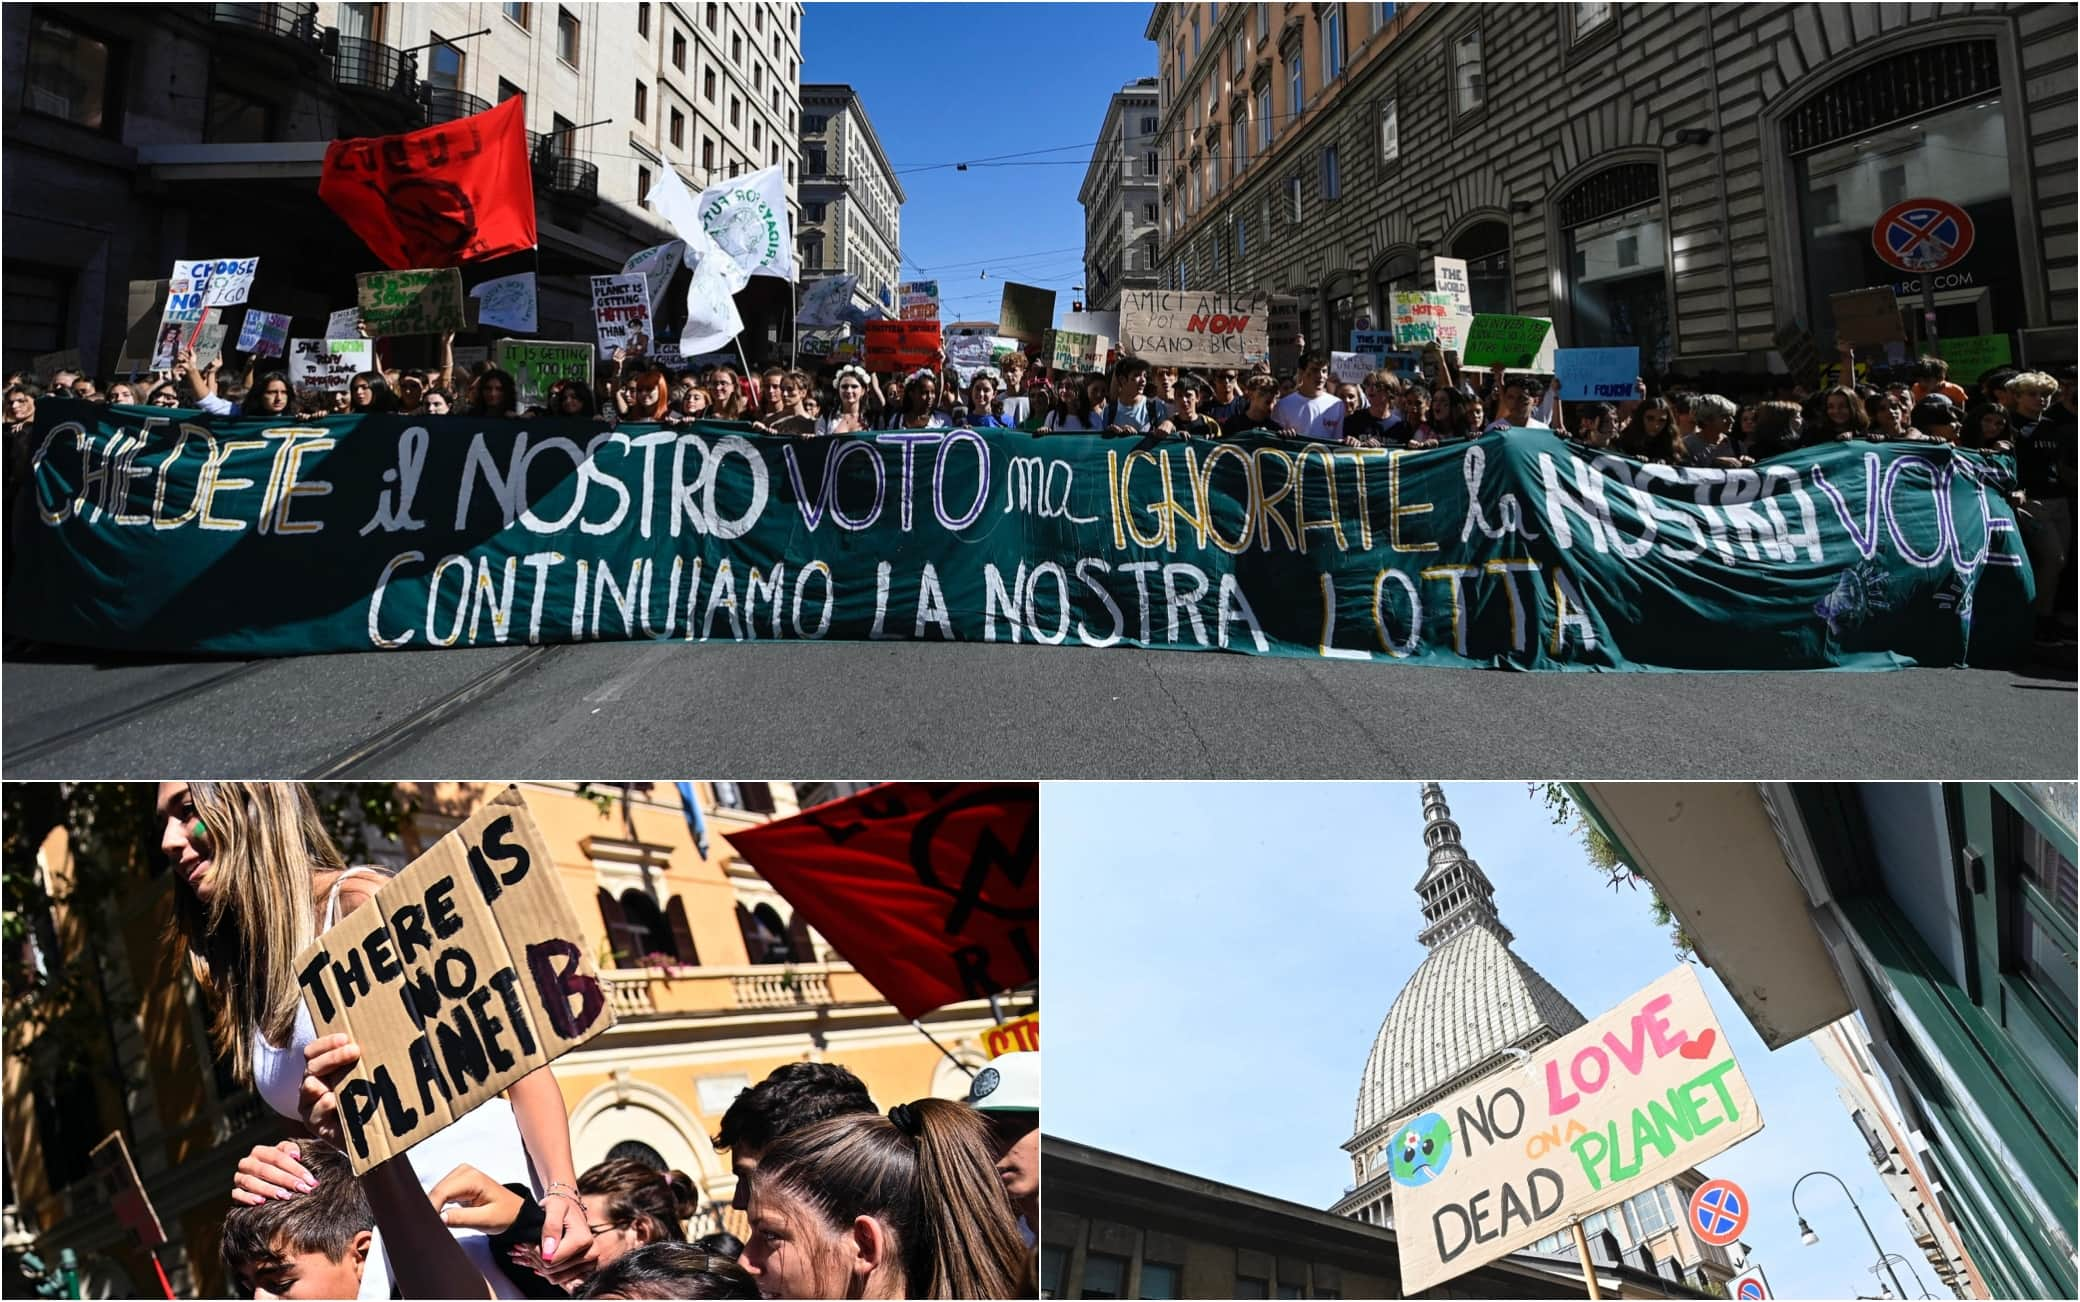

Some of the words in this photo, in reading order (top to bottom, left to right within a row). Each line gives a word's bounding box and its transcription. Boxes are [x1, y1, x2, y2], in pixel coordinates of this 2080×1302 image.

[592, 277, 612, 286] THE
[1441, 268, 1461, 280] THE
[595, 285, 630, 297] PLANET
[632, 283, 642, 293] IS
[597, 295, 640, 307] GETTING
[1124, 292, 1184, 312] AMICI
[597, 304, 649, 322] HOTTER
[599, 326, 626, 339] THAN
[1187, 313, 1250, 335] NON
[506, 347, 516, 360] IT
[540, 347, 588, 361] GETTING
[1131, 336, 1193, 352] USANO
[536, 363, 560, 376] TOO
[563, 363, 587, 377] HOT
[34, 417, 335, 536] CHIEDETE
[359, 427, 432, 537] il
[454, 431, 769, 540] NOSTRO
[783, 430, 991, 532] VOTO
[1003, 455, 1099, 524] ma
[1108, 442, 1440, 555] IGNORATE
[1460, 445, 1540, 543] la
[1538, 455, 1825, 567] NOSTRA
[368, 551, 835, 649] CONTINUIAMO
[869, 560, 959, 641] LA
[983, 556, 1271, 653] NOSTRA
[1320, 558, 1598, 660] LOTTA
[298, 873, 464, 1025] THERE
[466, 814, 532, 907] IS
[399, 946, 478, 1032] NO
[337, 966, 538, 1160] PLANET
[525, 937, 606, 1041] B
[1457, 1087, 1525, 1158] NO
[1545, 993, 1690, 1117] LOVE
[1525, 1120, 1564, 1161] ON
[1432, 1167, 1565, 1264] DEAD
[1569, 1058, 1741, 1191] PLANET
